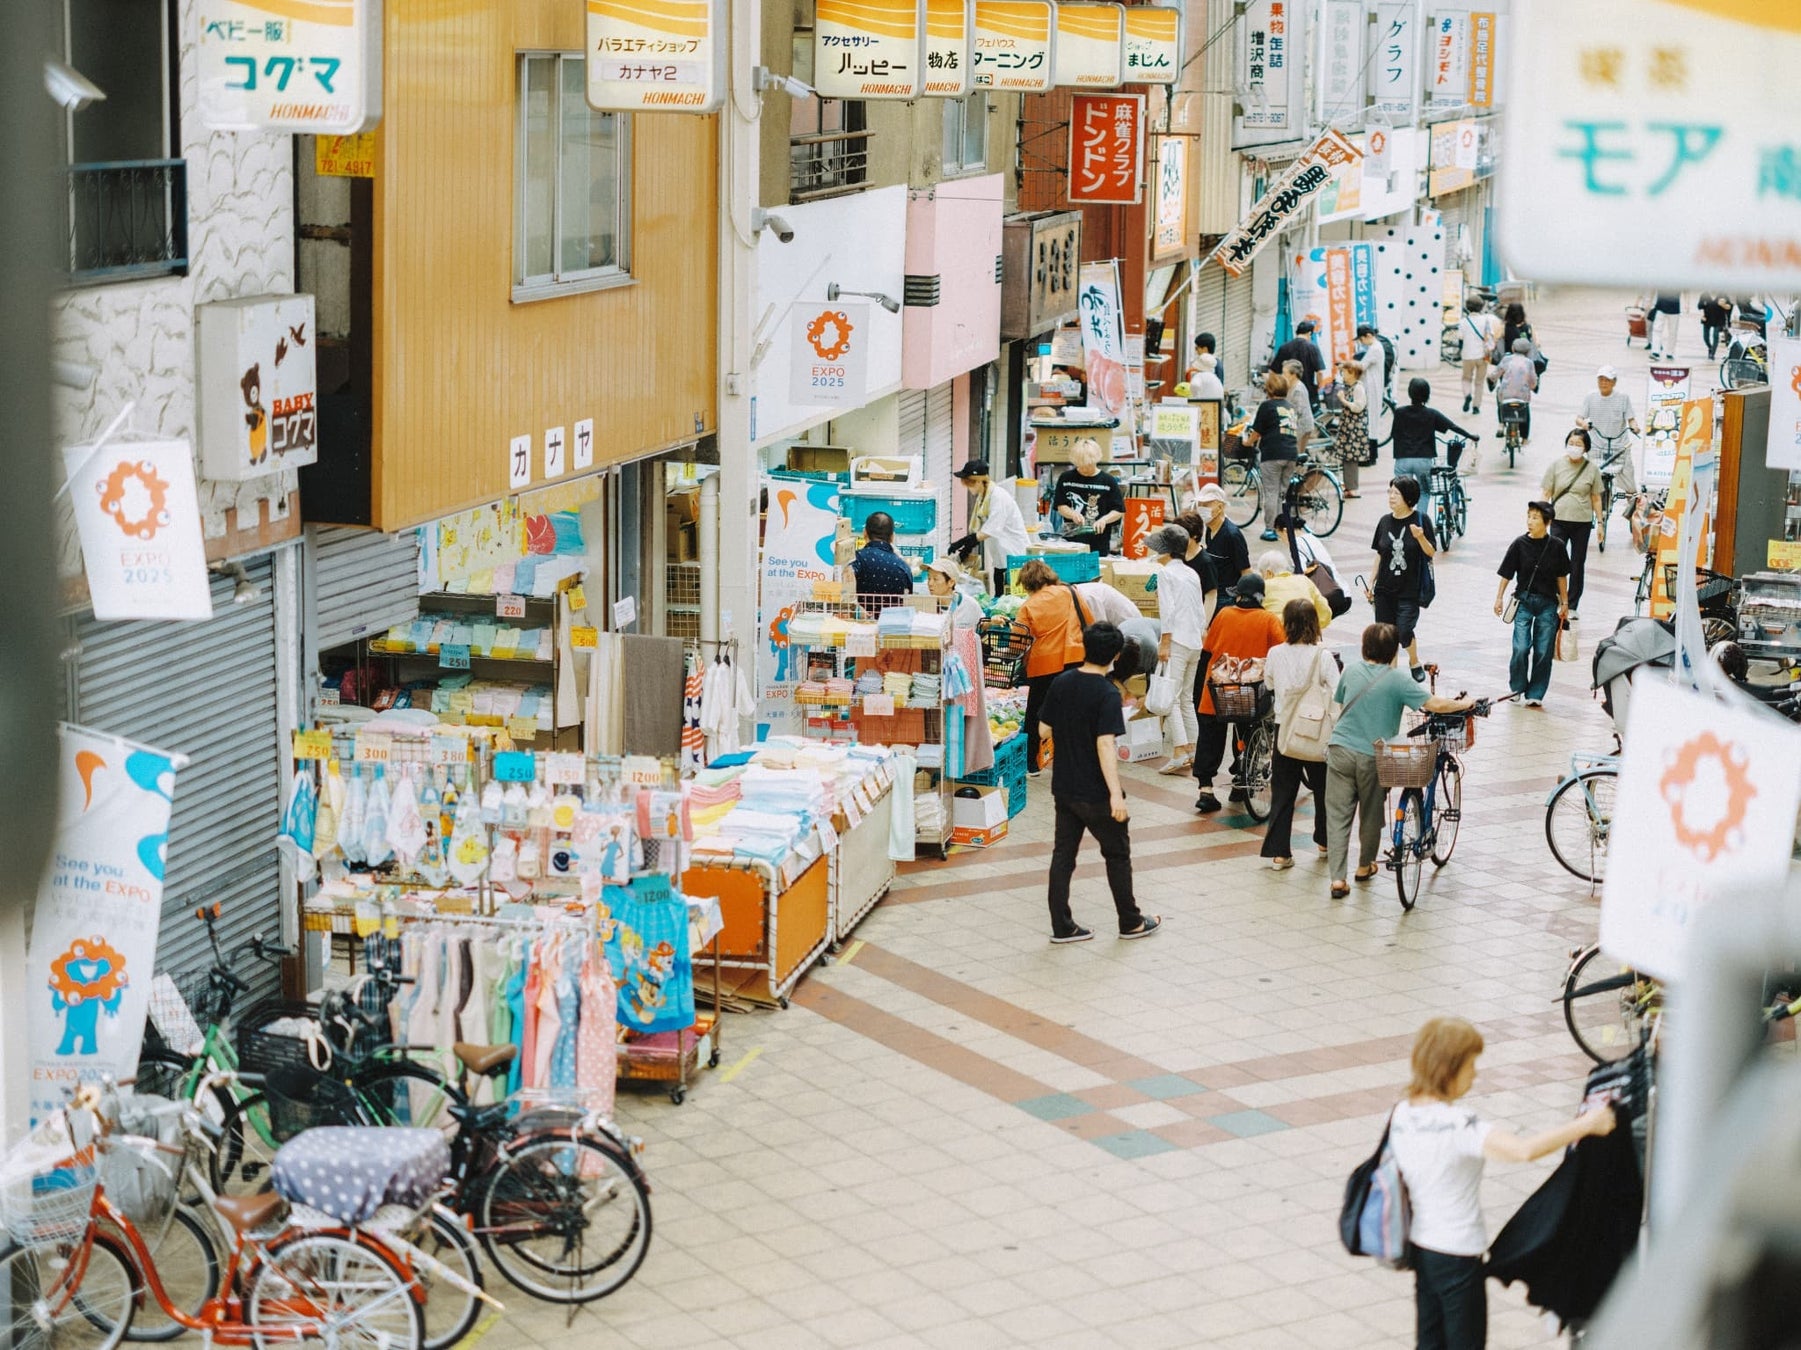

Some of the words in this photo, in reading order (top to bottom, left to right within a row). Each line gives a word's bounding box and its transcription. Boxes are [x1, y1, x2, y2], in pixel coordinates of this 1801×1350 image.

[207, 20, 284, 42] ベビー服
[1269, 2, 1285, 68] 果物缶詰
[597, 37, 700, 53] バラエティショップ
[822, 35, 879, 47] アクセサリー
[975, 38, 1016, 48] フェハウス
[1386, 20, 1407, 83] グラフ
[838, 52, 907, 75] ハッピー
[1128, 53, 1170, 67] まじん
[1437, 35, 1452, 85] ヨシモト
[224, 56, 341, 94] コグマ
[619, 65, 678, 80] カナヤ2
[1076, 75, 1115, 84] HONMACHI
[860, 83, 912, 95] HONMACHI
[1000, 78, 1045, 88] HONMACHI
[642, 92, 706, 105] HONMACHI
[270, 103, 350, 121] HONMACHI
[1081, 103, 1108, 193] ドンドン
[1113, 104, 1133, 187] 麻雀クラブ
[1557, 119, 1725, 199] モア
[811, 367, 845, 377] EXPO
[811, 377, 844, 387] 2025
[272, 392, 314, 416] BABY
[272, 408, 314, 450] コグマ
[513, 424, 590, 477] カナヤ
[121, 552, 169, 567] EXPO
[768, 557, 788, 566] See
[790, 557, 808, 568] you
[123, 568, 173, 583] 2025
[767, 570, 777, 578] at
[779, 570, 795, 578] the
[797, 570, 825, 581] EXPO
[504, 606, 521, 615] 220
[449, 658, 467, 668] 250
[766, 690, 788, 698] EXPO
[365, 748, 388, 759] 300
[442, 751, 465, 762] 380
[509, 767, 532, 778] 250
[56, 854, 89, 871] See
[94, 862, 124, 877] you
[53, 876, 68, 888] at
[74, 876, 100, 891] the
[105, 880, 151, 904] EXPO
[644, 891, 670, 902] 1200
[33, 1067, 79, 1081] EXPO
